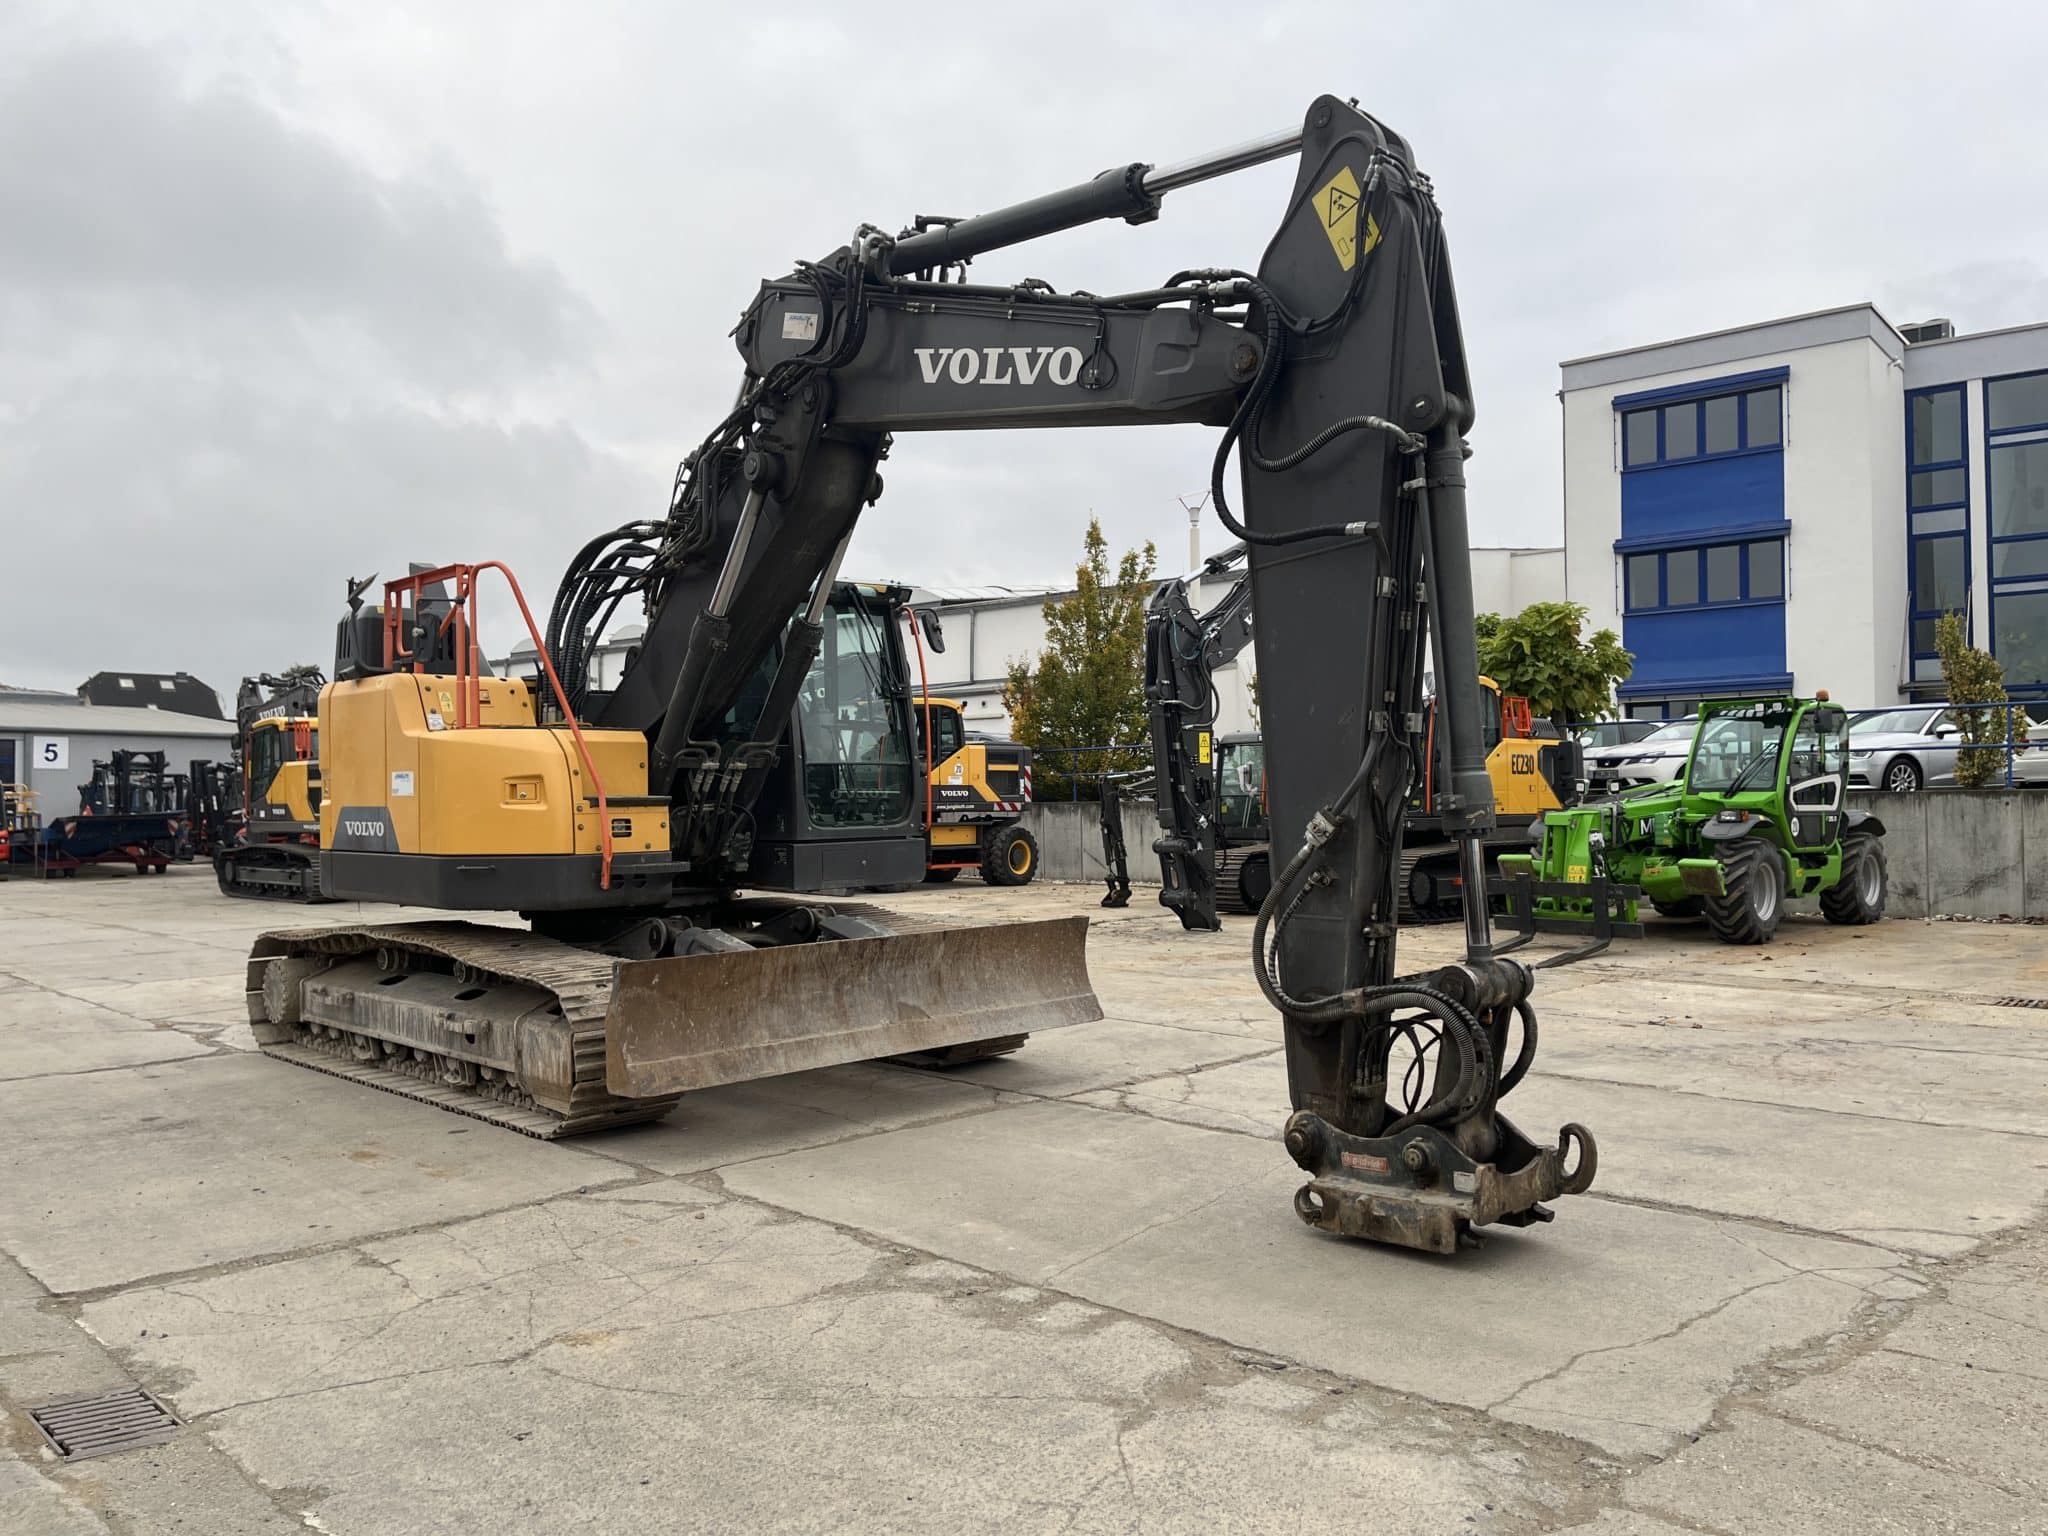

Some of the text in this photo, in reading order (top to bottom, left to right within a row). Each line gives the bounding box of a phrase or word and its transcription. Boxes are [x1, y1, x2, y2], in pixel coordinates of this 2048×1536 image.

[914, 346, 1083, 385] VOLVO
[44, 743, 58, 762] 5
[1511, 754, 1535, 775] EC230
[344, 820, 385, 837] VOLVO
